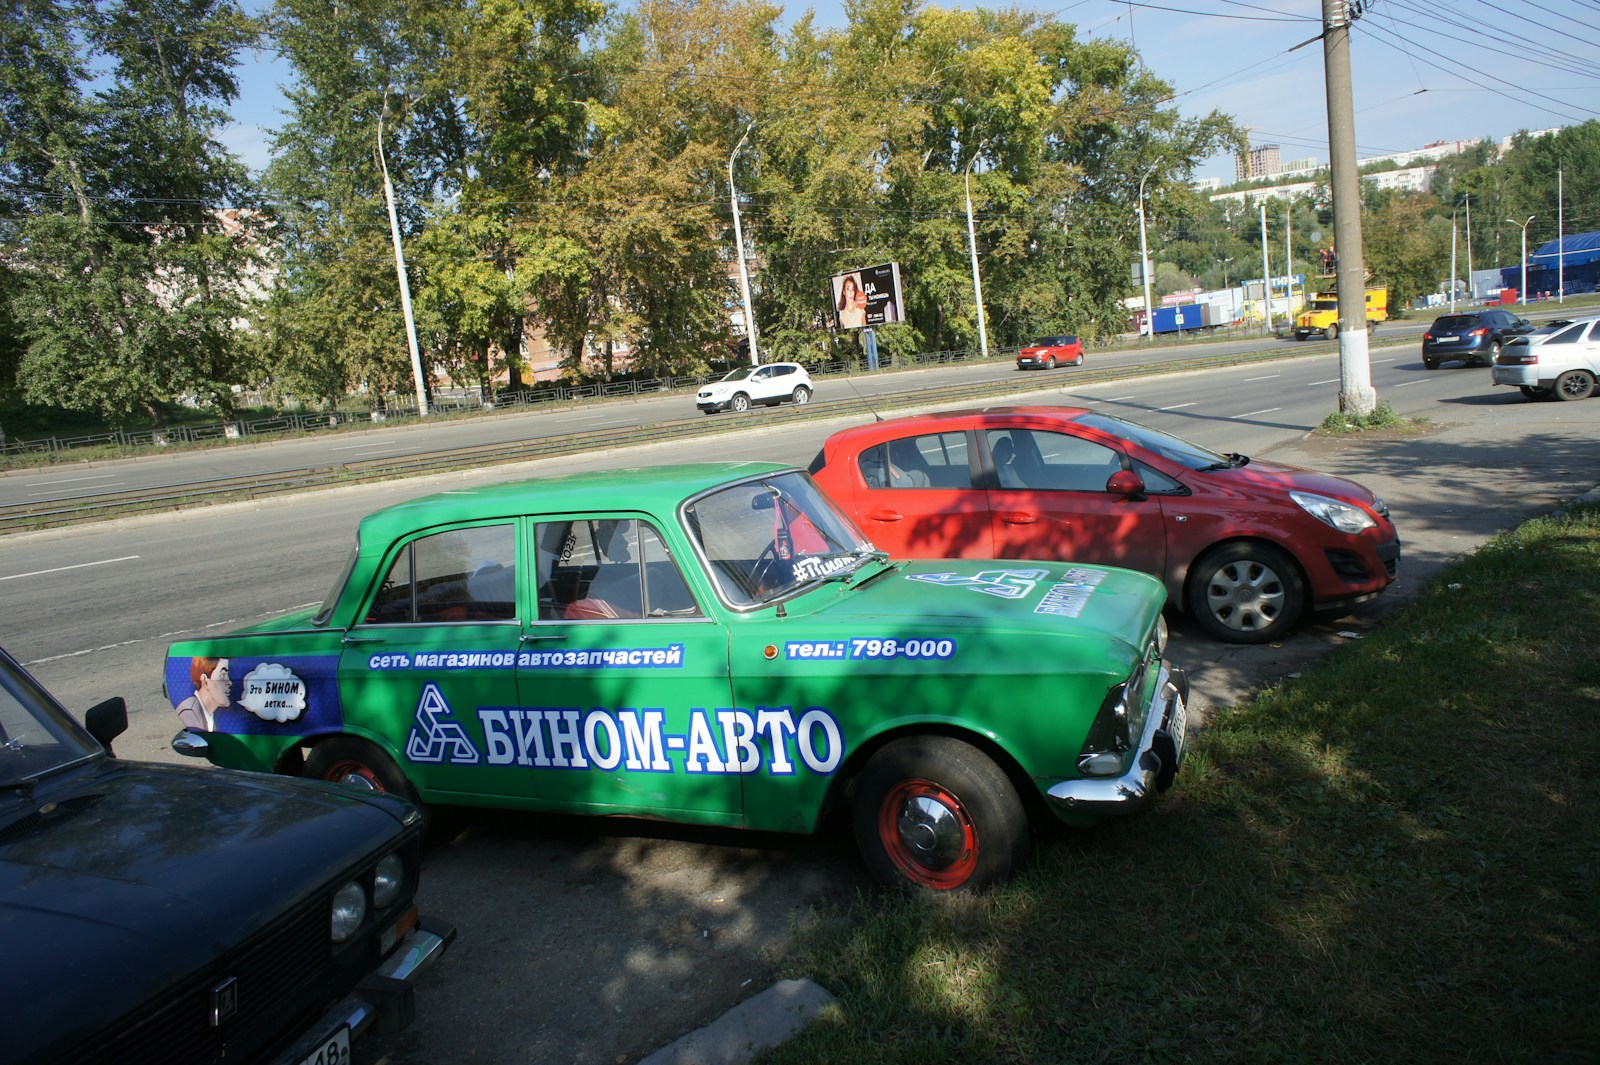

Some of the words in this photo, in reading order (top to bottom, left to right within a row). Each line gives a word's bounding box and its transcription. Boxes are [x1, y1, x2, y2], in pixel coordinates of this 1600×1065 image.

[370, 654, 409, 668] сеть
[415, 651, 515, 667] магазинов
[518, 645, 680, 666] автозапчастей
[787, 643, 844, 657] тел.:
[852, 639, 952, 657] 798-000
[250, 684, 262, 694] Это
[477, 708, 843, 774] БИНОМ-АВТО
